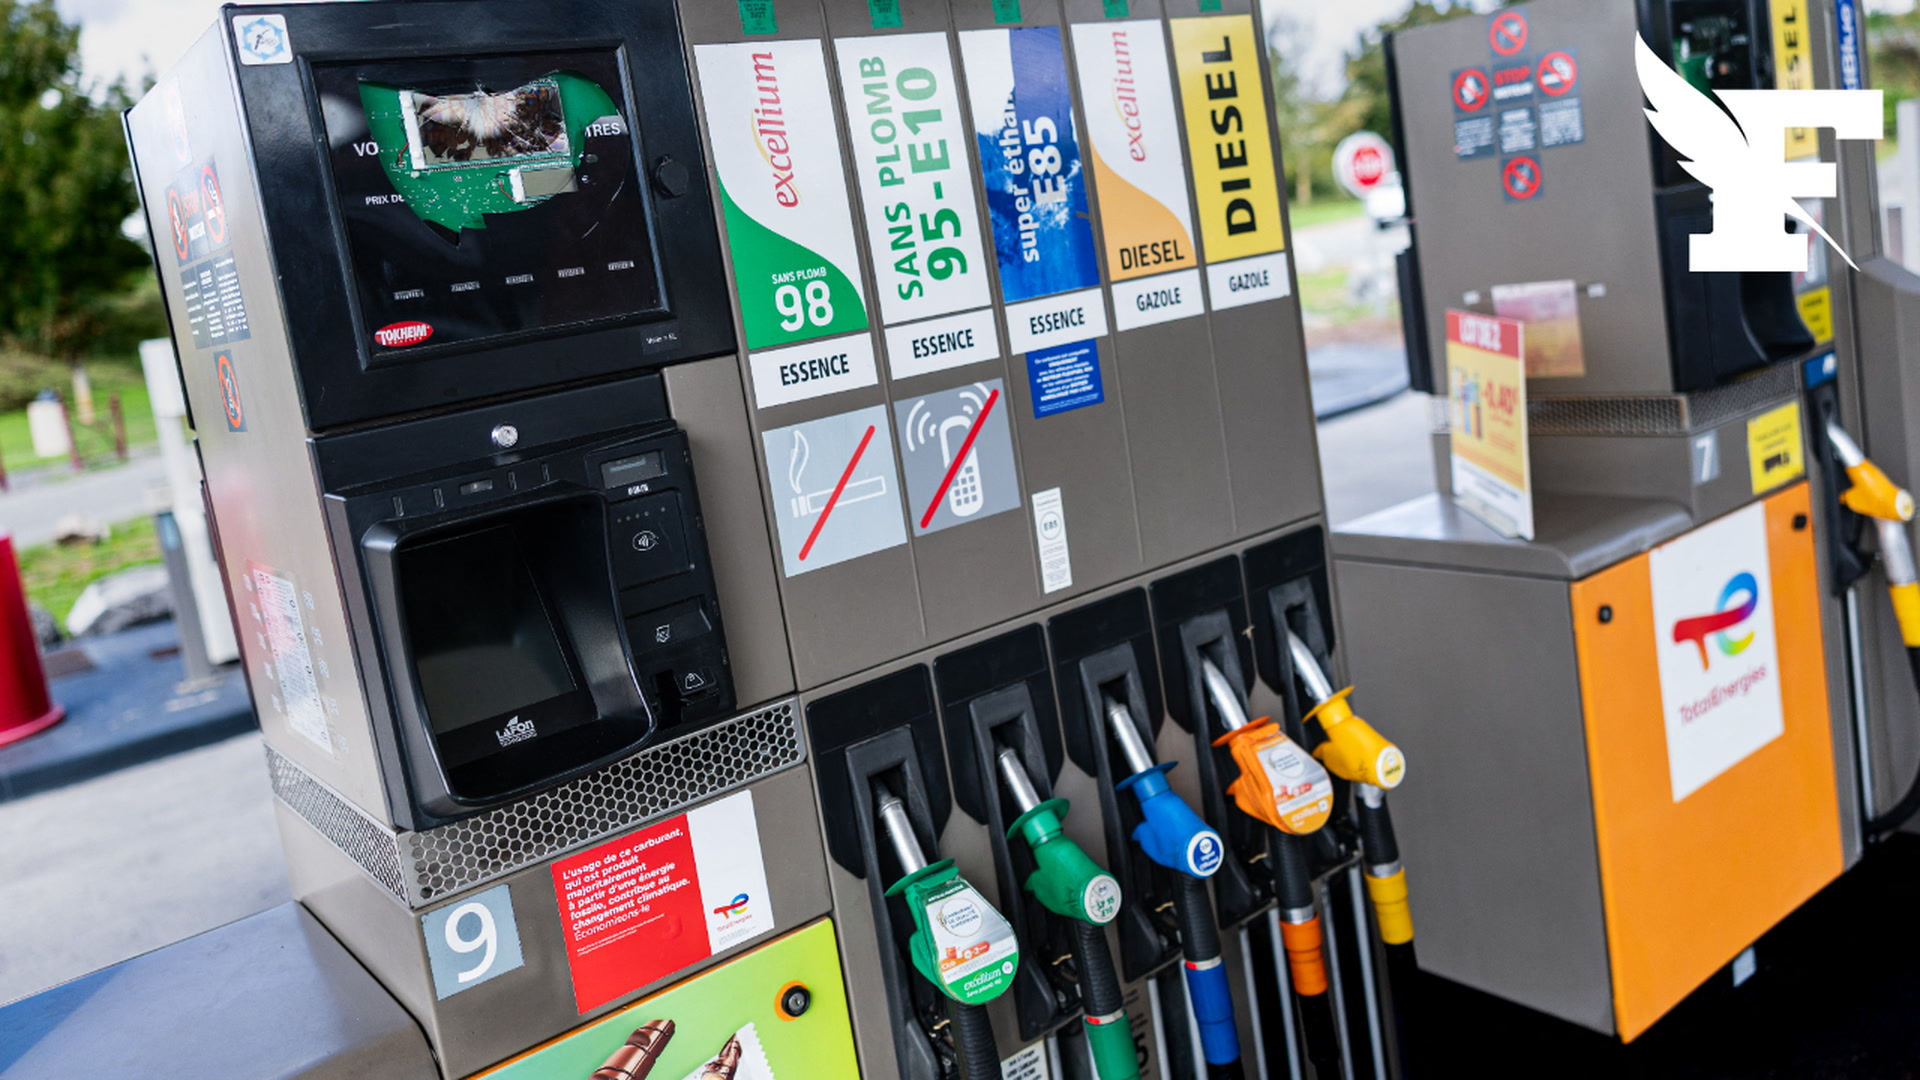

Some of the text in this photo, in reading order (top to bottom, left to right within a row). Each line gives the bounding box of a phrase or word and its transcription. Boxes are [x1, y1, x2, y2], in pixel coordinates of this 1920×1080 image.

[1112, 31, 1146, 162] excellium
[1782, 4, 1806, 141] DESEL
[585, 122, 621, 137] TRES
[752, 52, 798, 208] excellium
[859, 56, 905, 187] PLOMB
[1202, 36, 1257, 236] DIESEL
[353, 141, 379, 157] VO
[1023, 115, 1067, 206] E85
[896, 67, 968, 281] 95-E10
[999, 92, 1040, 263] super éthan
[365, 195, 390, 206] PRIX
[772, 266, 827, 285] SANS PLOMB
[885, 202, 924, 301] SANS
[1120, 240, 1184, 270] DIESEL
[1137, 287, 1182, 312] GAZOLE
[1229, 270, 1269, 293] GAZOLE
[775, 280, 834, 332] 98
[1030, 307, 1085, 335] ESSENCE
[377, 325, 428, 346] TOKHEIM
[912, 329, 974, 359] ESSENCE
[780, 353, 850, 387] ESSENCE
[1696, 434, 1713, 481] 7
[1678, 664, 1767, 725] TotalEnergies
[563, 828, 684, 880] L'usage de ce carburant,
[565, 855, 639, 891] qui est produit
[566, 863, 647, 900] majoritairement
[568, 862, 676, 911] à partir d'une énergie
[570, 875, 670, 920] fossile, contribue au
[572, 877, 691, 931] changement climatique.
[445, 902, 497, 984] 9
